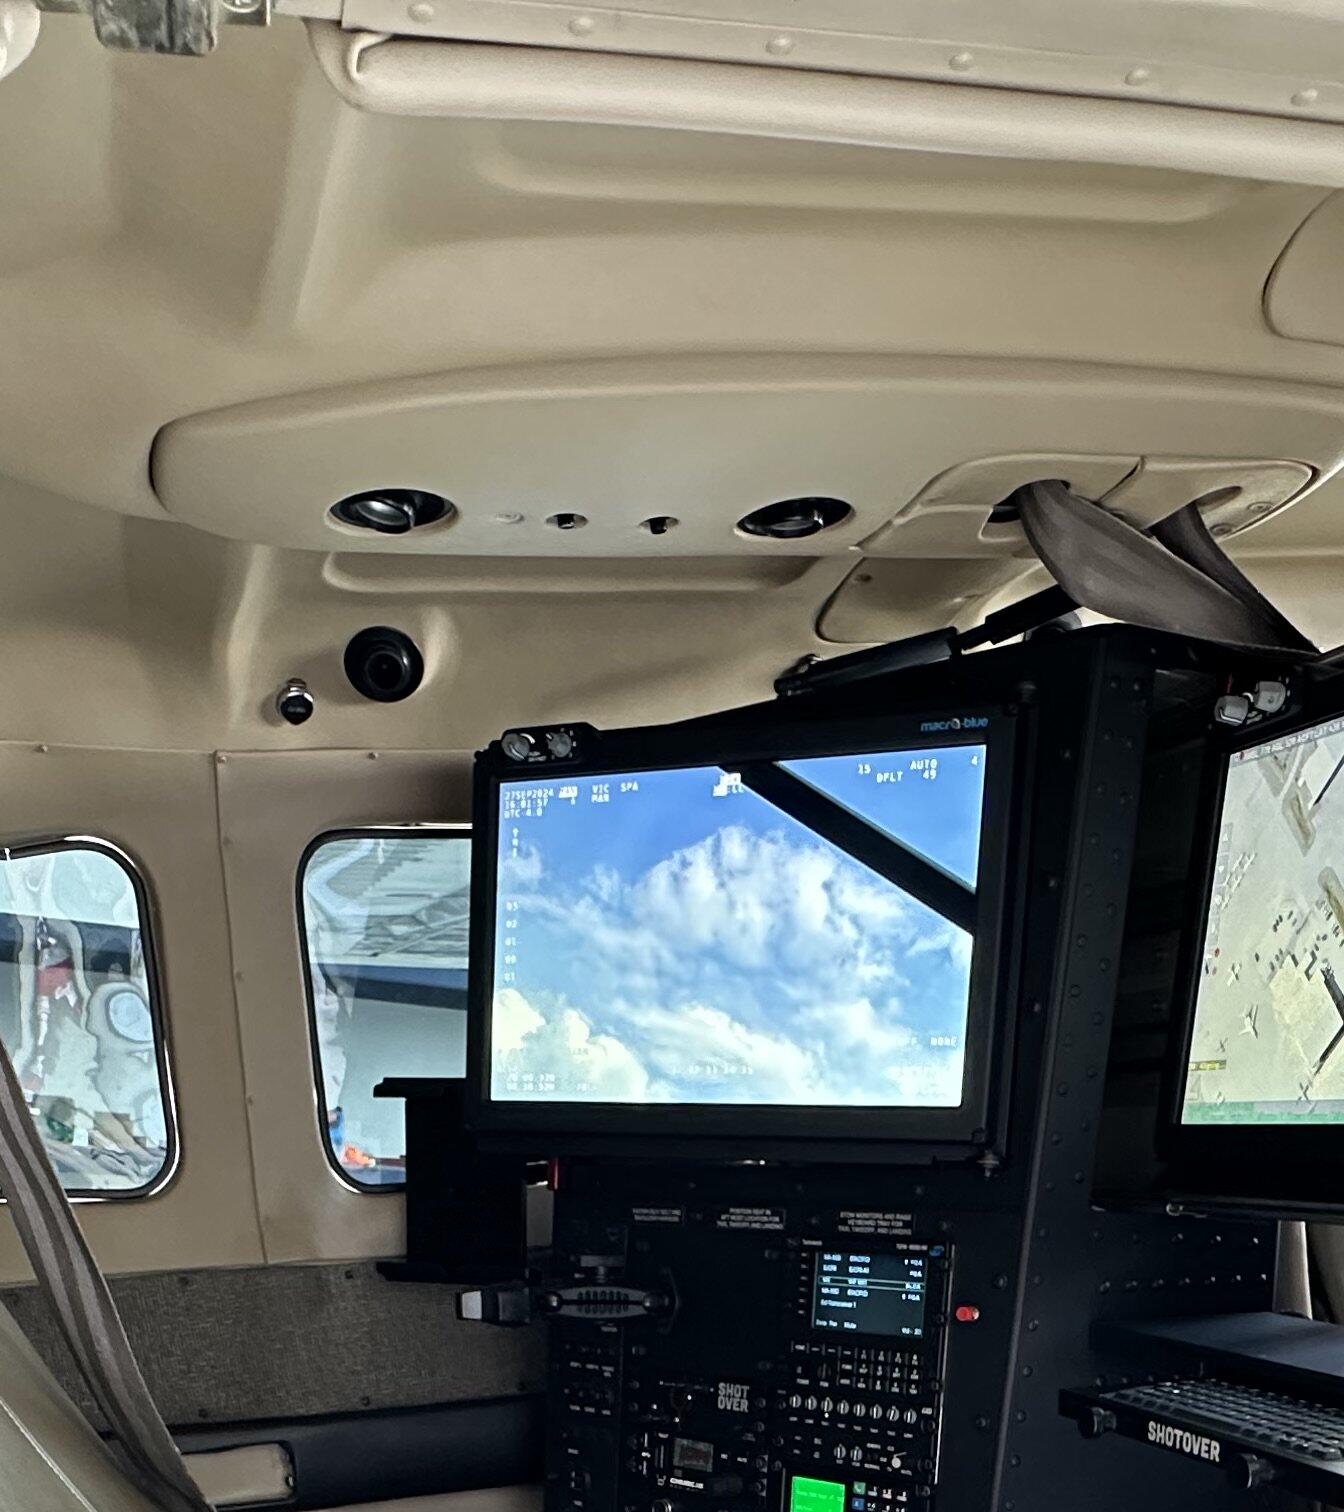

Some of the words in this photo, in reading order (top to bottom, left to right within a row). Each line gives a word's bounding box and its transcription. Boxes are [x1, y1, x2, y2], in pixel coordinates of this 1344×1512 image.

[909, 758, 938, 770] AUTO
[876, 771, 903, 783] DFLT
[923, 769, 937, 780] 49
[504, 787, 555, 801] 27SEP2024
[718, 1382, 750, 1399] SHOT
[717, 1396, 749, 1413] OVER
[1147, 1421, 1220, 1462] SHOTOVER
